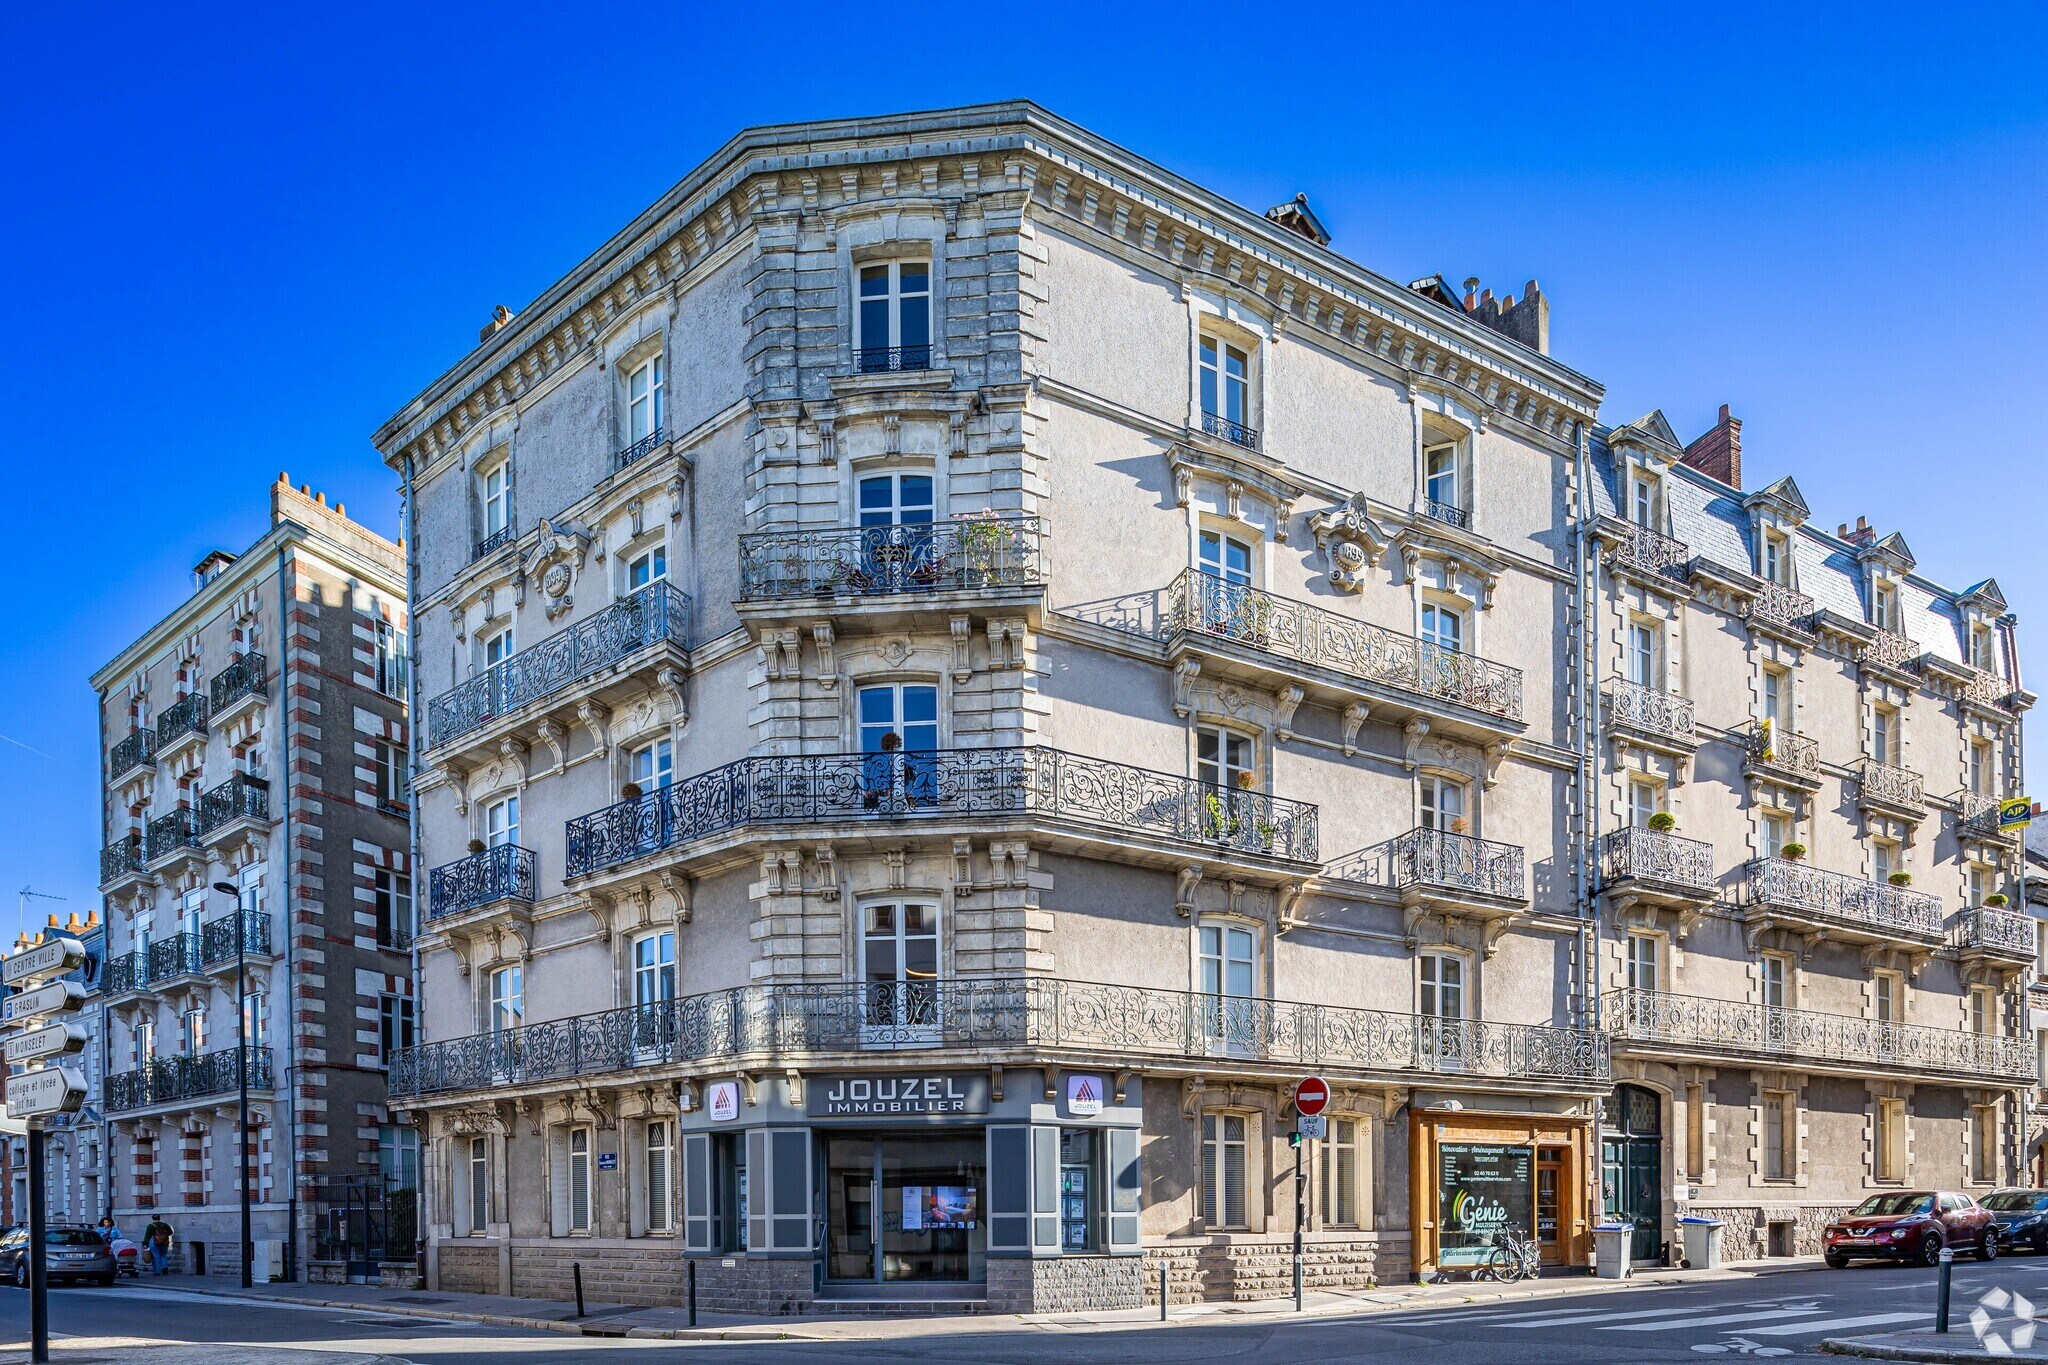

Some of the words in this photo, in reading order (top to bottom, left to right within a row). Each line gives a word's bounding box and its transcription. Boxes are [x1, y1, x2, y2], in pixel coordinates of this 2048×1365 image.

[1342, 545, 1364, 562] 1899
[545, 569, 562, 588] 899
[2006, 805, 2025, 817] AJP
[13, 956, 36, 974] CENTRE
[38, 948, 55, 965] VILLE
[14, 996, 40, 1014] GRASLIN
[15, 1035, 46, 1053] MONSELET
[31, 1080, 38, 1091] et
[40, 1076, 56, 1091] lycée
[828, 1078, 965, 1101] JOUZEL
[828, 1101, 964, 1113] IMMOBILIER
[1460, 1196, 1508, 1232] Génie
